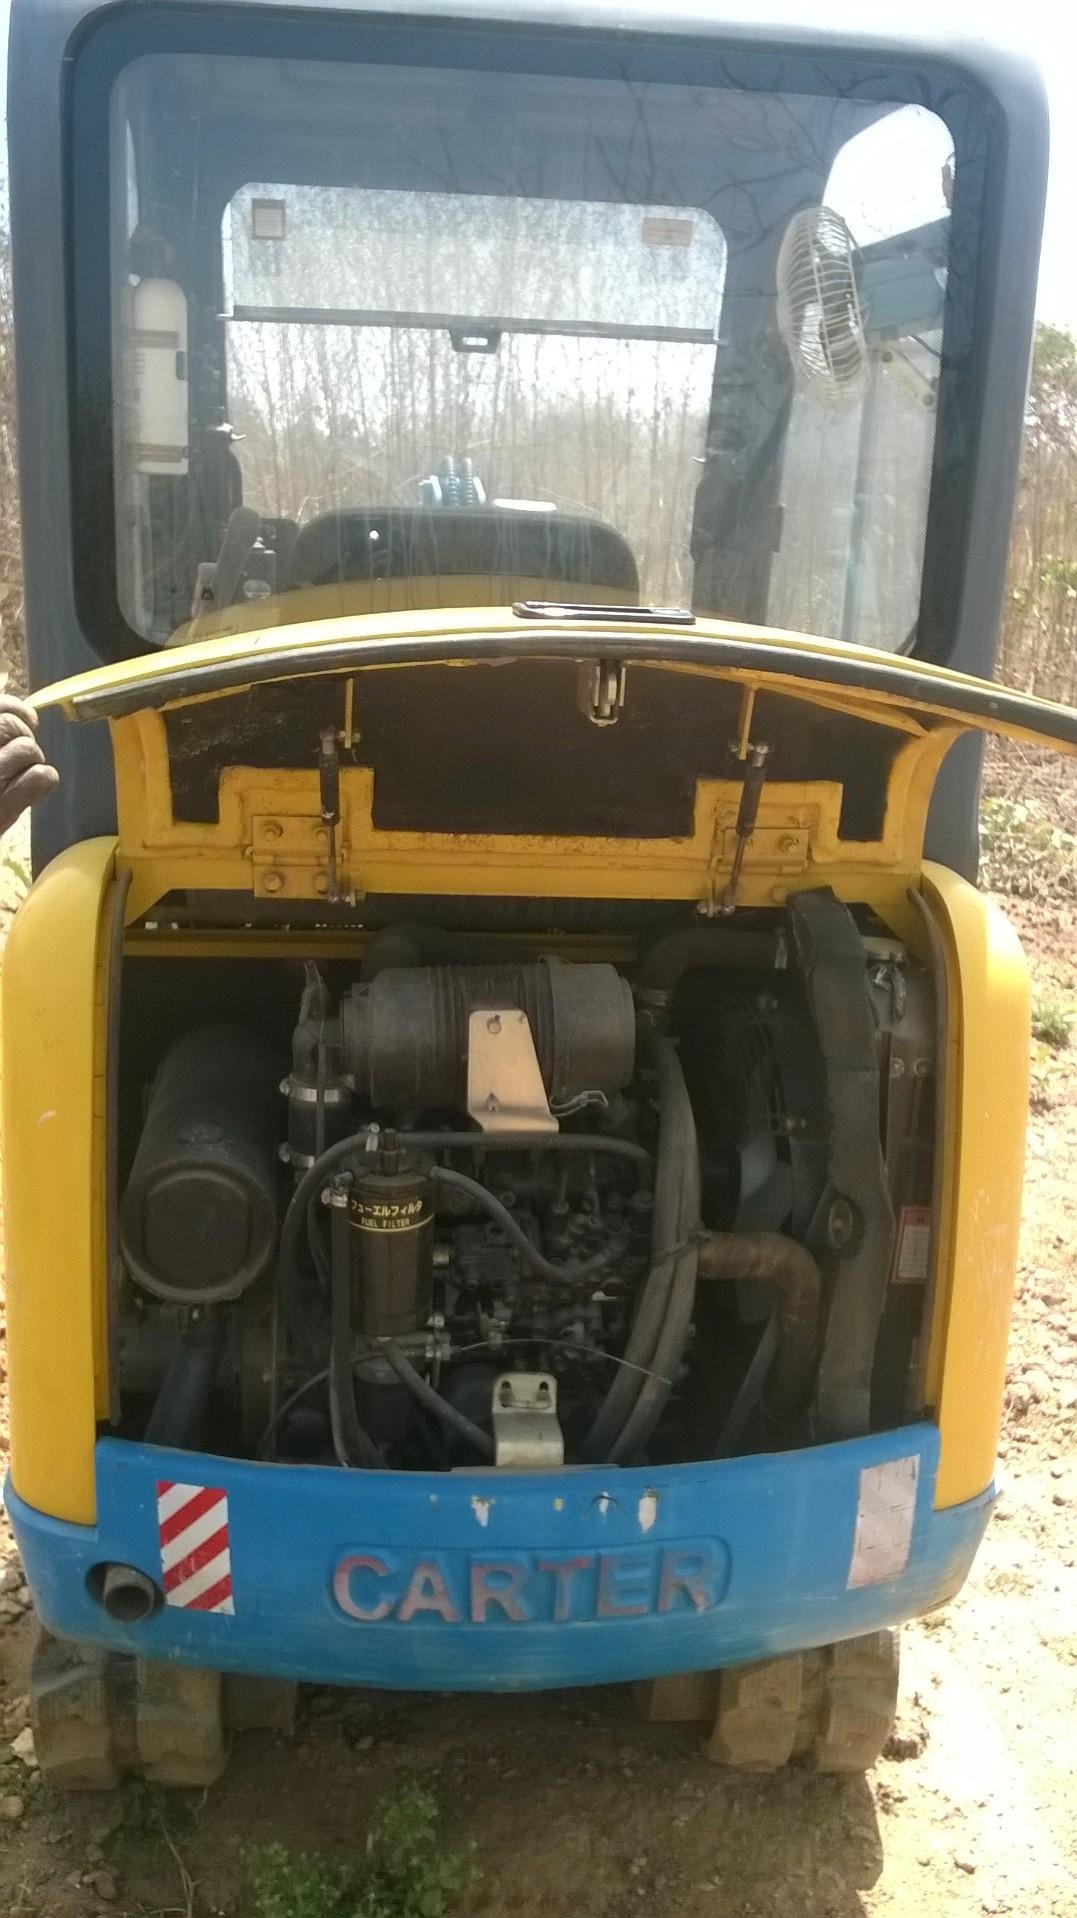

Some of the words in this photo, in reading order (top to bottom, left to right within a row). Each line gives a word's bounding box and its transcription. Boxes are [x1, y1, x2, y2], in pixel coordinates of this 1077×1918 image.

[361, 1217, 378, 1228] FUEL
[383, 1218, 410, 1228] FILTER
[333, 1546, 718, 1624] CARTER
